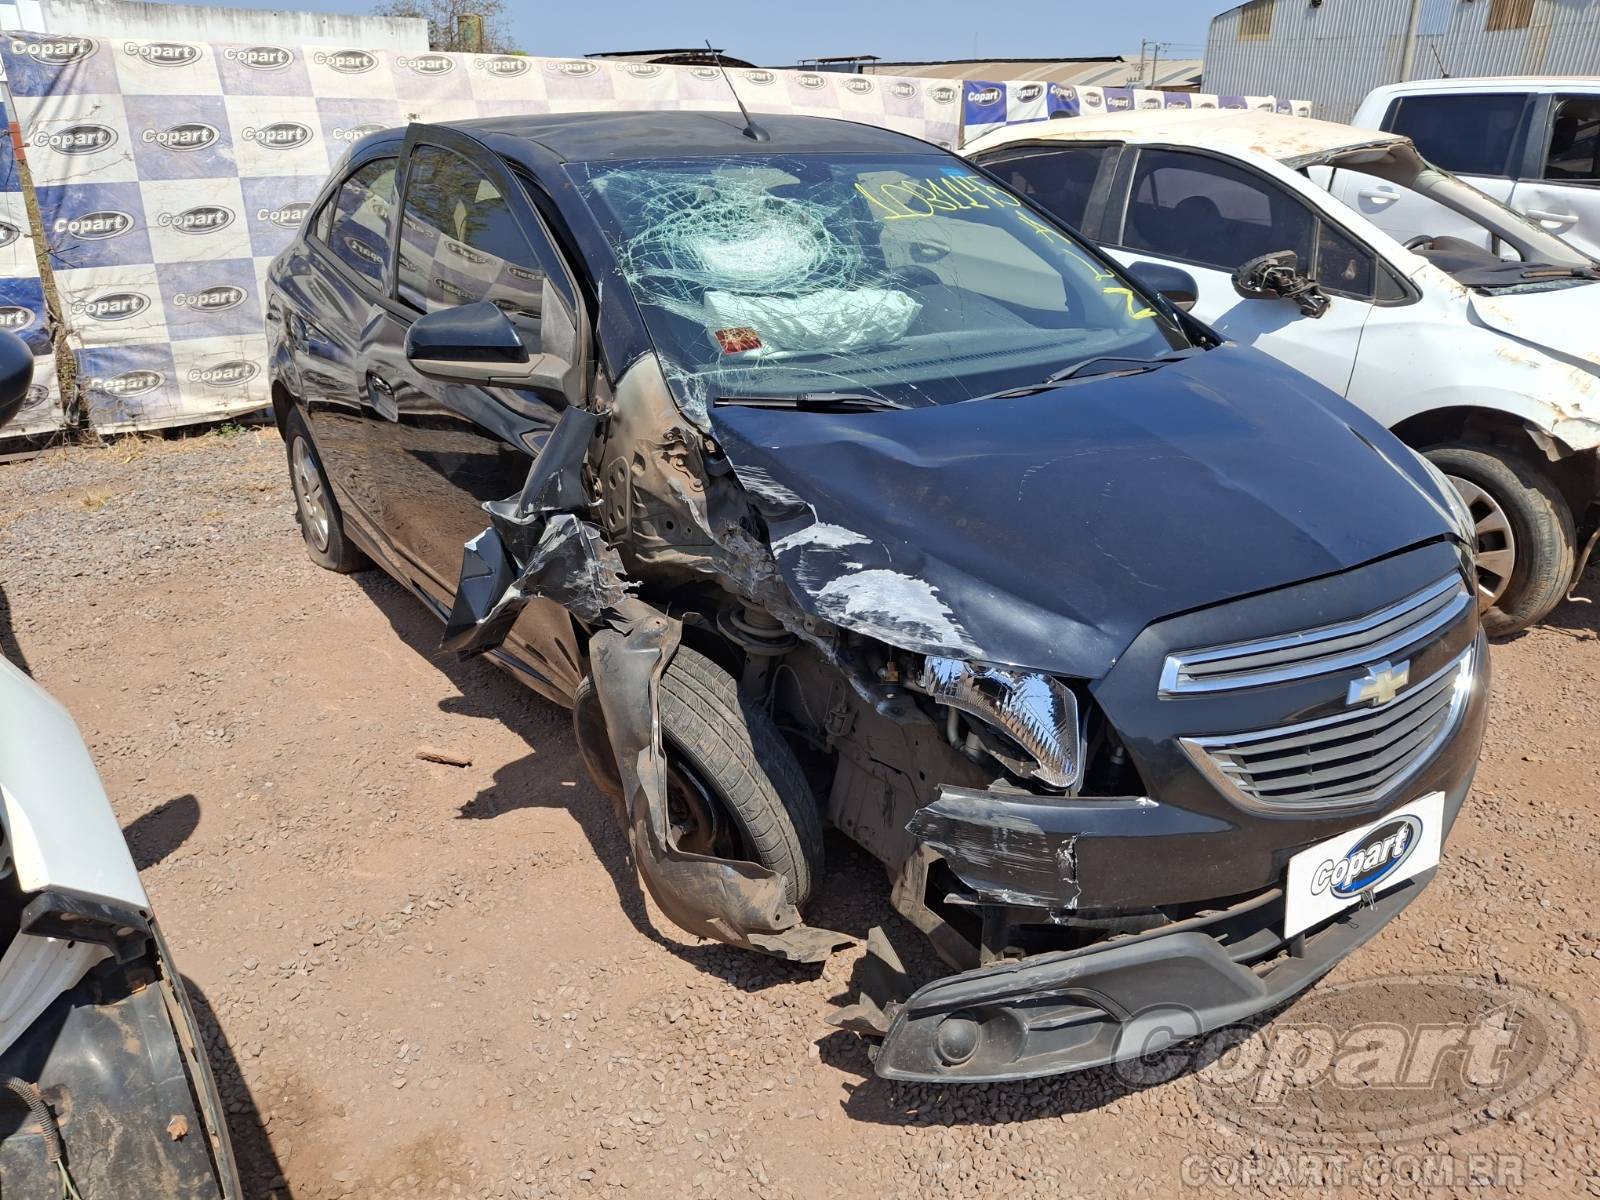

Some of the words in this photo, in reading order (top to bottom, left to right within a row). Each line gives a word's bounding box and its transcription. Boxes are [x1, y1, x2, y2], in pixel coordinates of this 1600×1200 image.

[11, 39, 87, 58] Copart
[124, 42, 193, 60] Copart
[224, 48, 285, 63] Copart
[314, 51, 369, 67] Copart
[397, 56, 450, 70] Copart
[474, 58, 525, 72] Copart
[547, 61, 593, 73] Copart
[968, 89, 998, 103] Copart
[1050, 84, 1074, 97] Copart
[34, 131, 105, 149] Copart
[142, 128, 210, 146] Copart
[242, 127, 304, 142] Copart
[332, 127, 368, 141] Cop
[157, 211, 224, 229] Copart
[256, 208, 308, 222] Copar
[55, 215, 123, 234] Copart
[71, 296, 140, 315] Copart
[173, 289, 239, 306] Copart
[187, 364, 251, 382] Copart
[90, 374, 157, 392] Copart
[1311, 820, 1411, 896] Copart
